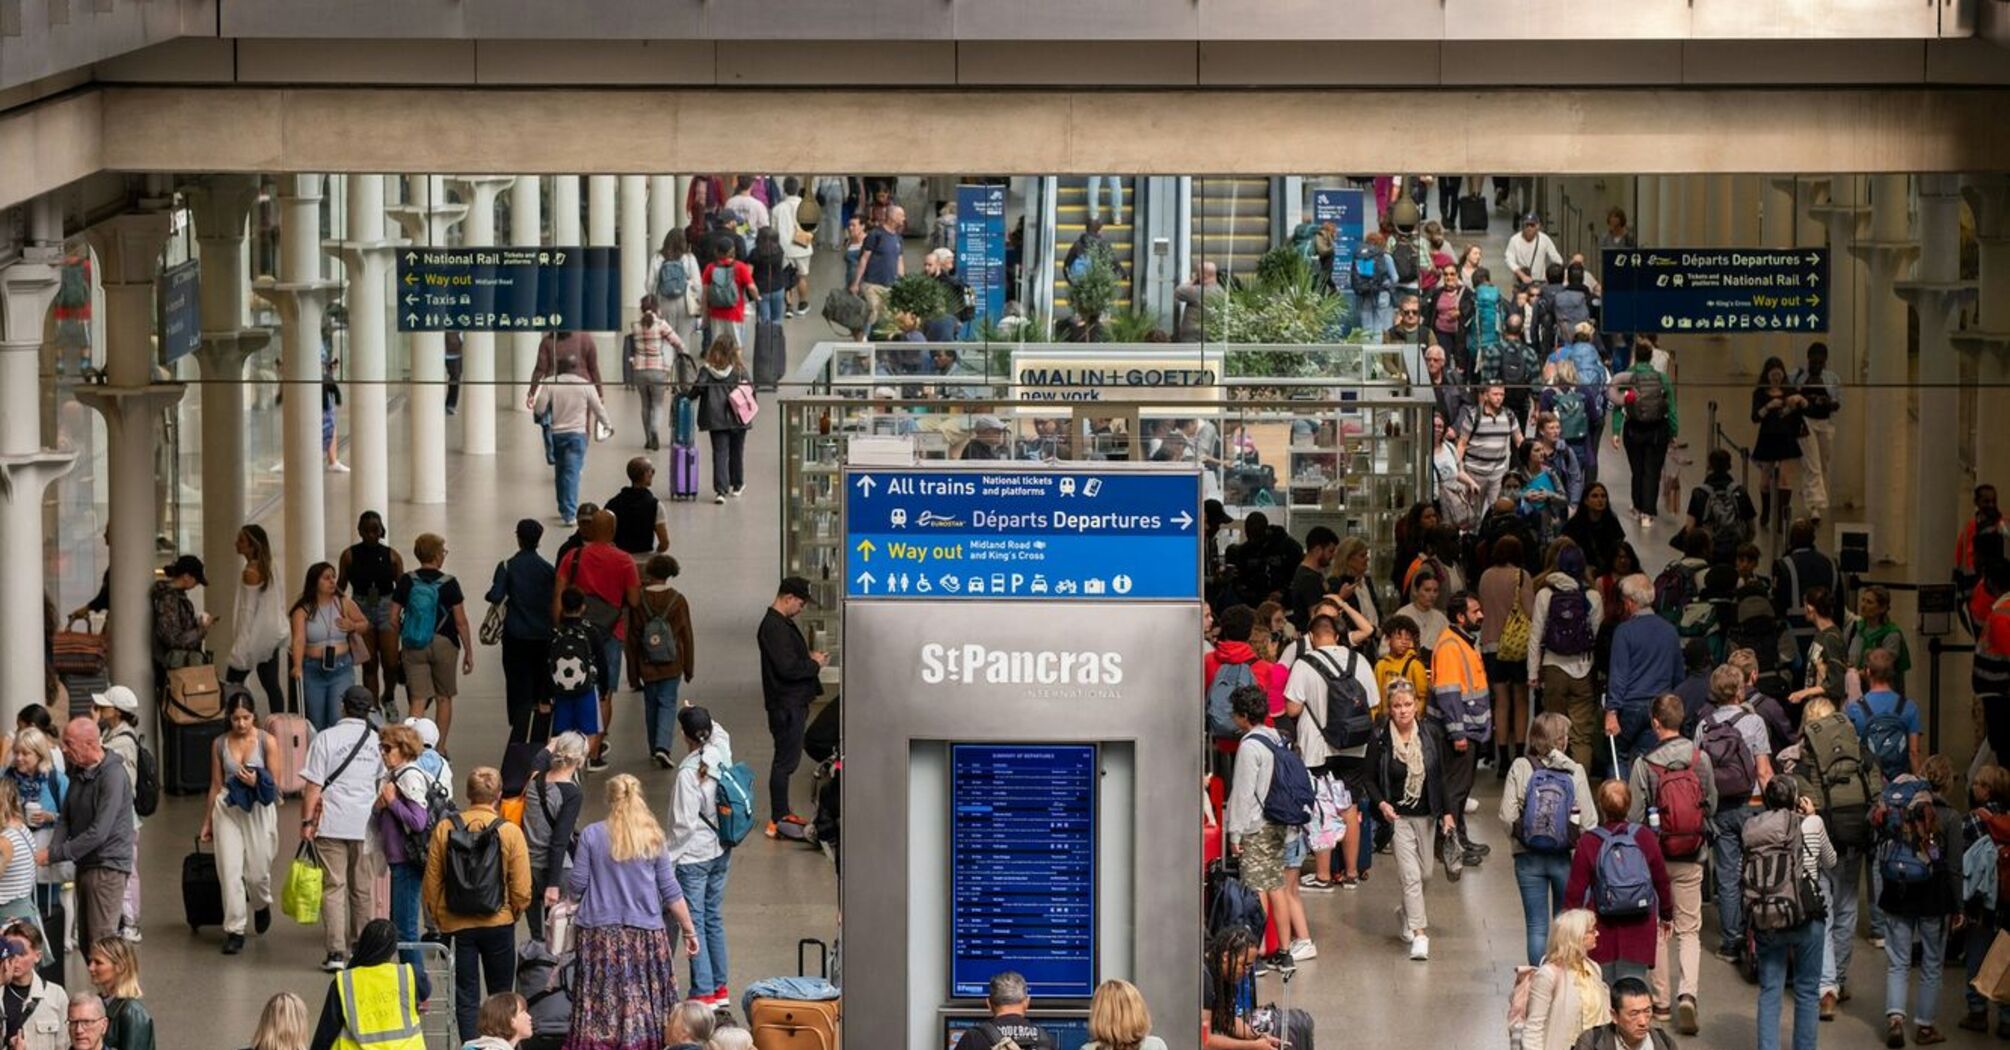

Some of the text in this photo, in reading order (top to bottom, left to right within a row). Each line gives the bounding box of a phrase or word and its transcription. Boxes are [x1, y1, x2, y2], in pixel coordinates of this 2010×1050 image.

[424, 253, 500, 264] National Rail
[1682, 253, 1730, 267] Départs
[1732, 254, 1800, 267] Departures
[424, 274, 472, 286] Way out
[1722, 274, 1800, 286] National Rail
[424, 294, 456, 306] Taxis
[1753, 295, 1800, 308] Way out
[1020, 391, 1056, 400] new
[887, 478, 976, 496] All trains
[982, 476, 1053, 486] National tickets
[982, 487, 1046, 498] and platforms
[973, 510, 1162, 532] Départs Departures
[970, 540, 1031, 550] Midland Road
[887, 542, 964, 564] Way out
[970, 552, 1044, 562] and King's Cross
